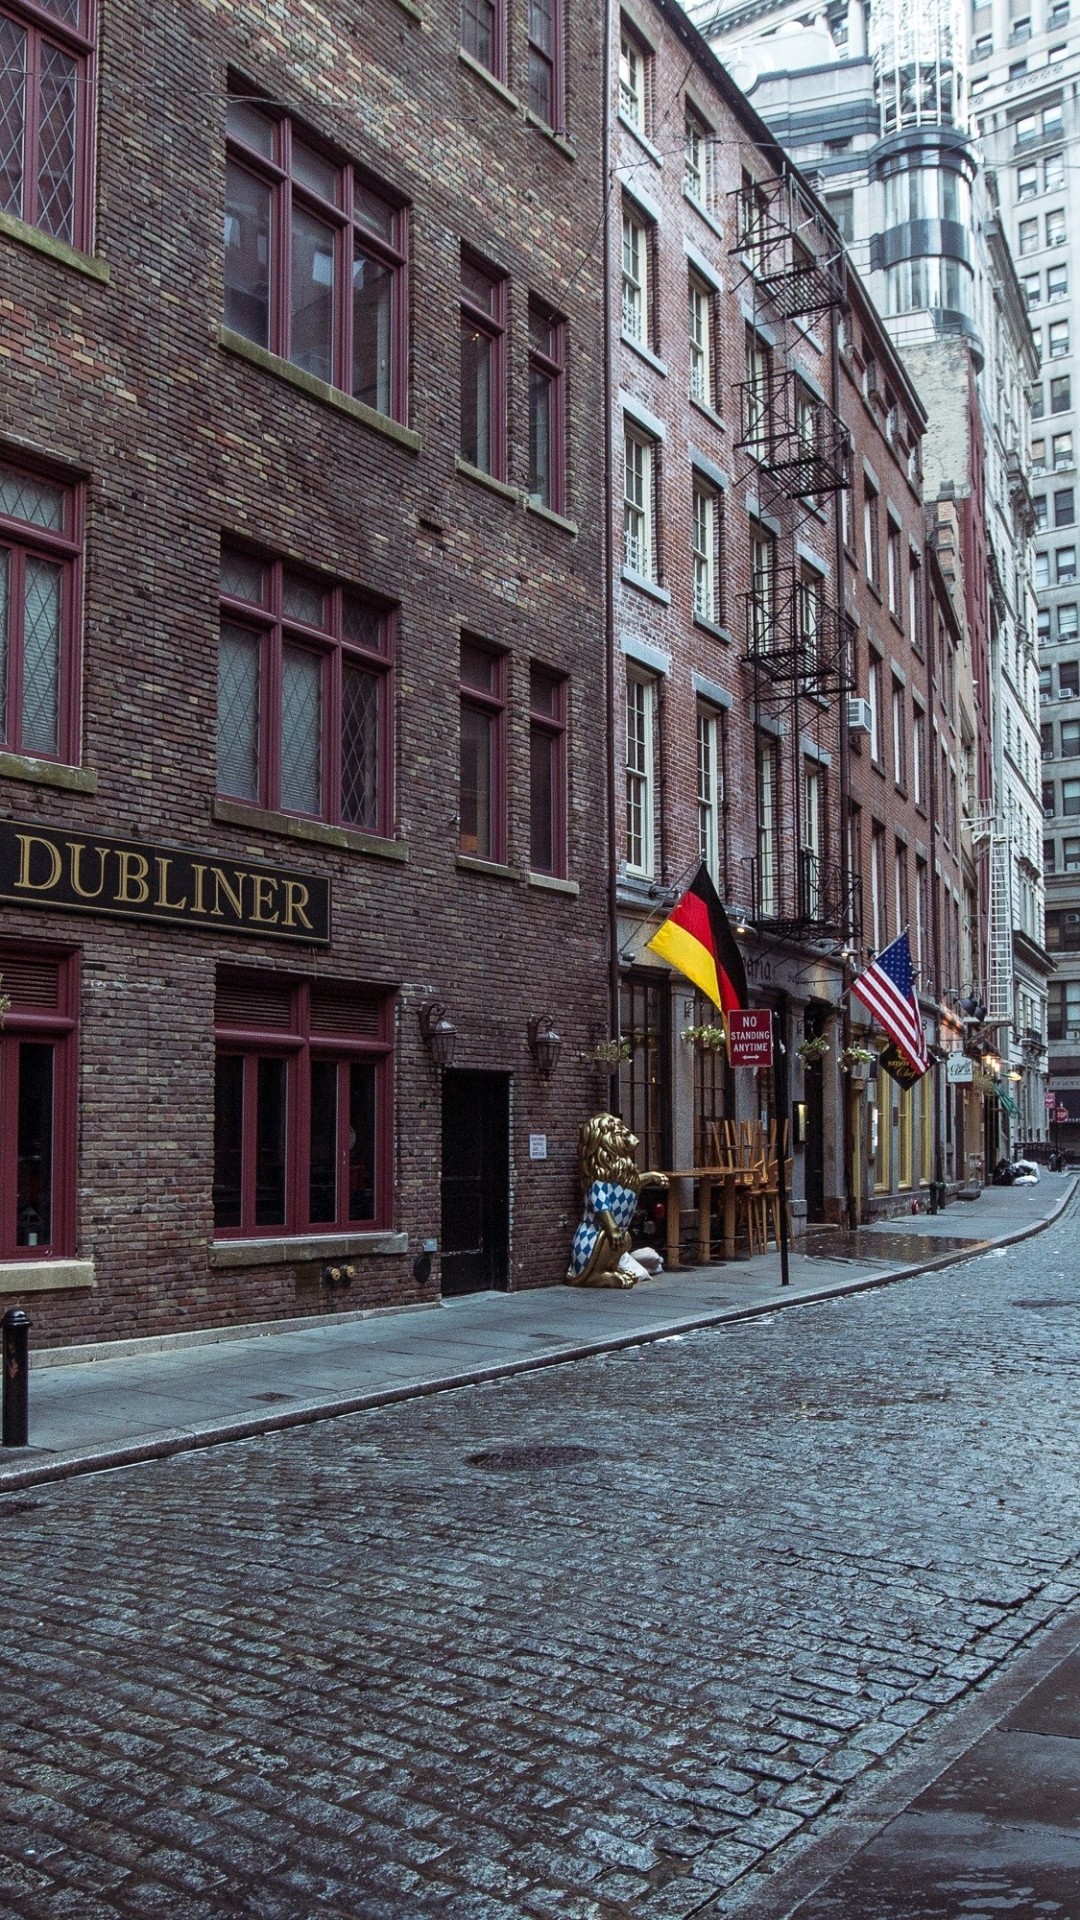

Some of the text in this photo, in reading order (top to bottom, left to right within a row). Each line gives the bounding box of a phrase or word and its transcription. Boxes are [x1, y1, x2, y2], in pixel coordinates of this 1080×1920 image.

[14, 834, 313, 929] DUBLINER
[742, 1016, 757, 1028] NO
[730, 1031, 770, 1041] STANDING
[733, 1043, 768, 1053] ANYTIME
